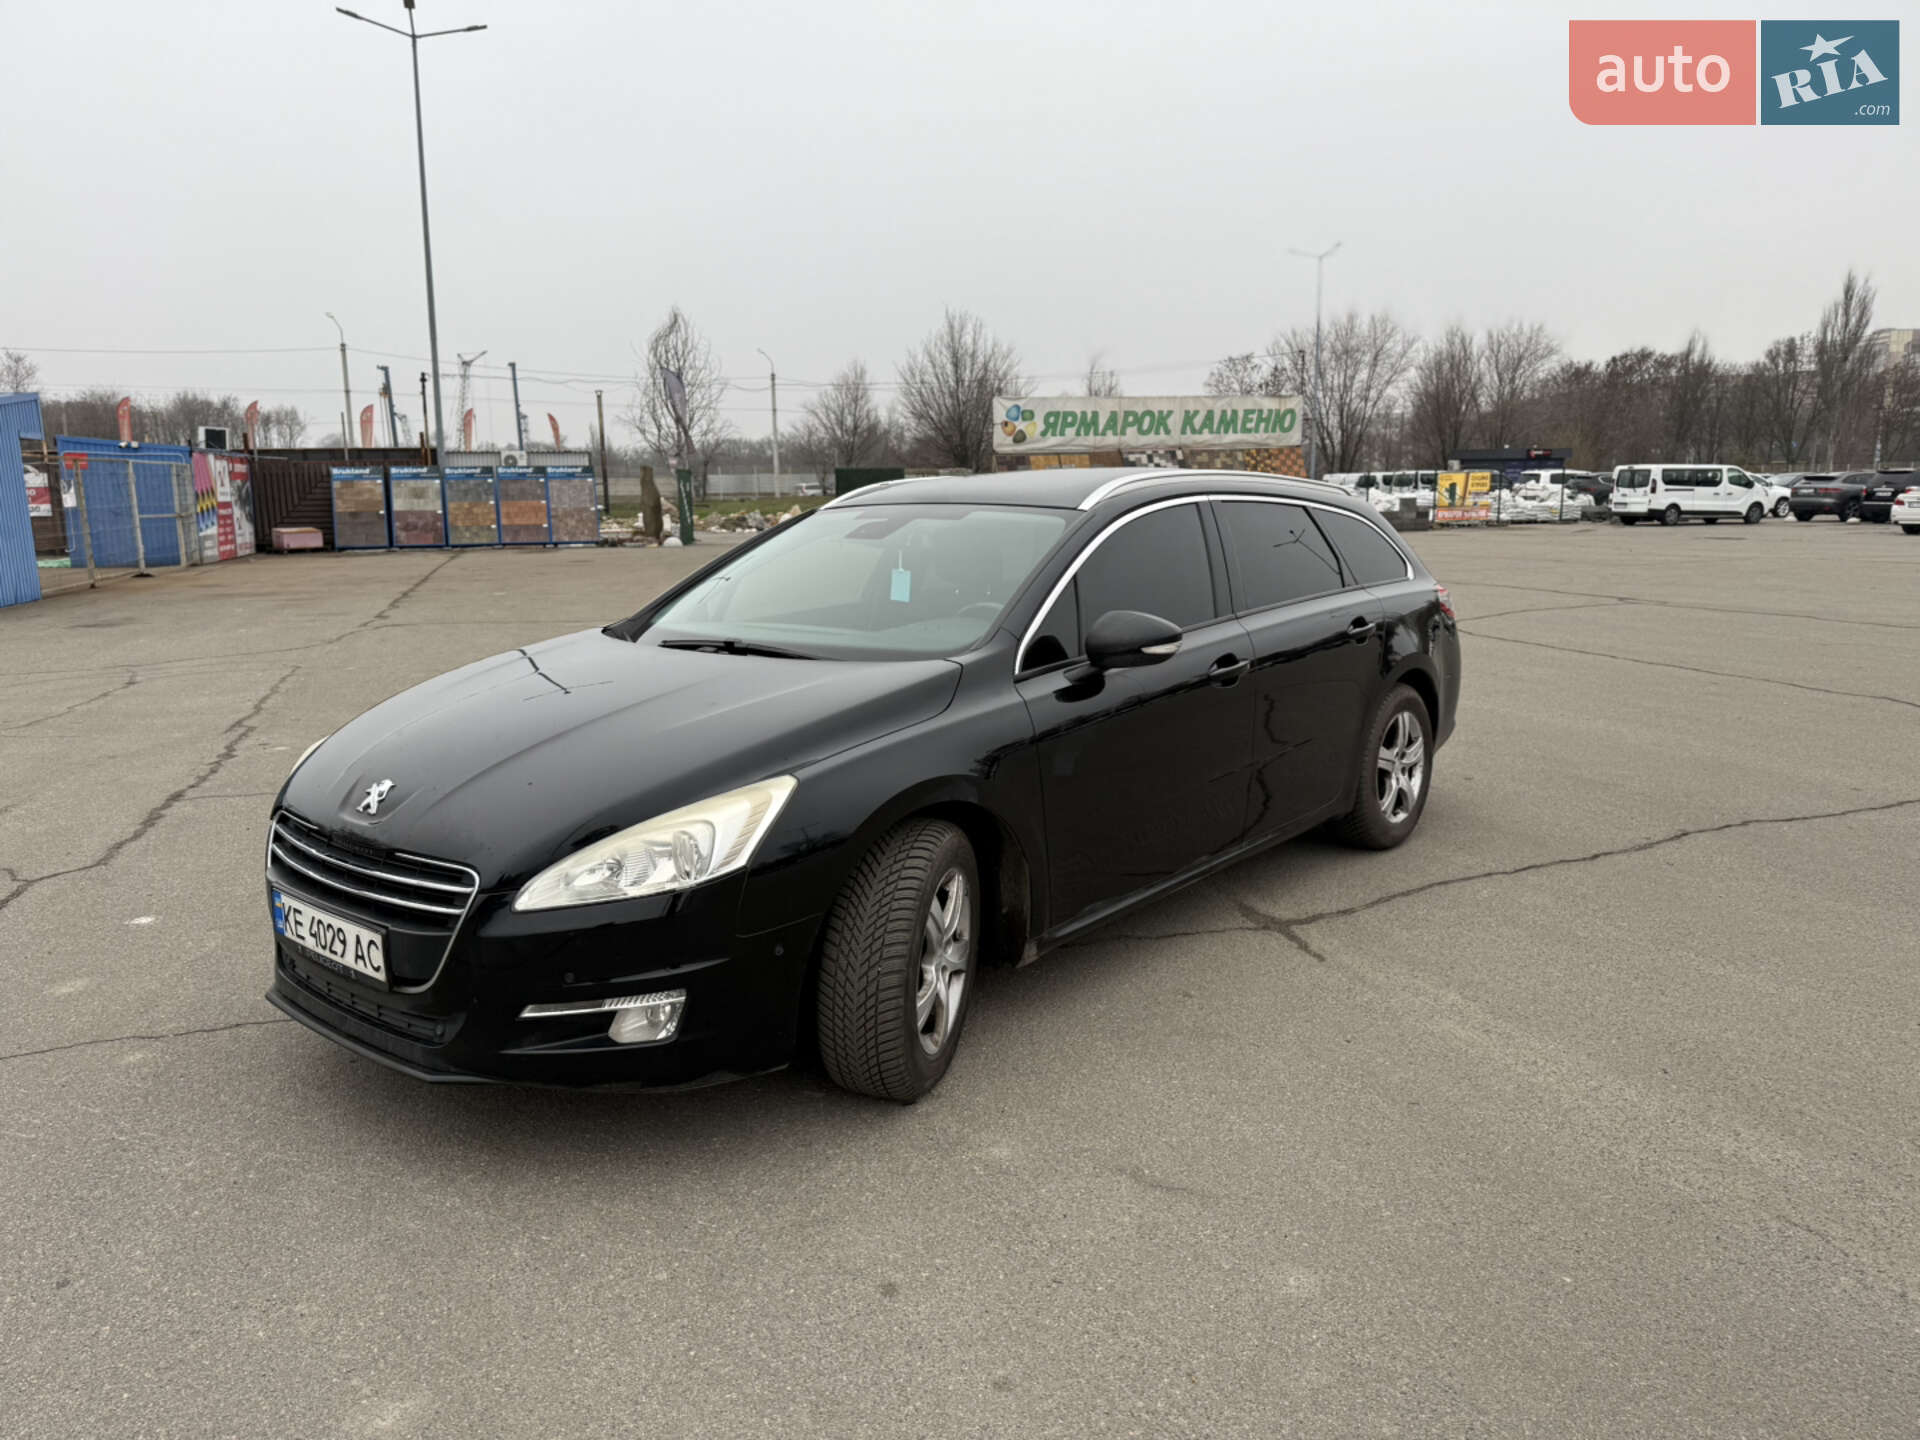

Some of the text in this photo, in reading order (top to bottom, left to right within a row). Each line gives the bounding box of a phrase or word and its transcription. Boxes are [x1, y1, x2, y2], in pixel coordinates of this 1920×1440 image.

[1040, 408, 1297, 437] ЯРМАРОК КАМЕНЮ
[282, 903, 305, 941] KE
[308, 916, 347, 958] 4029
[354, 934, 381, 973] AC
